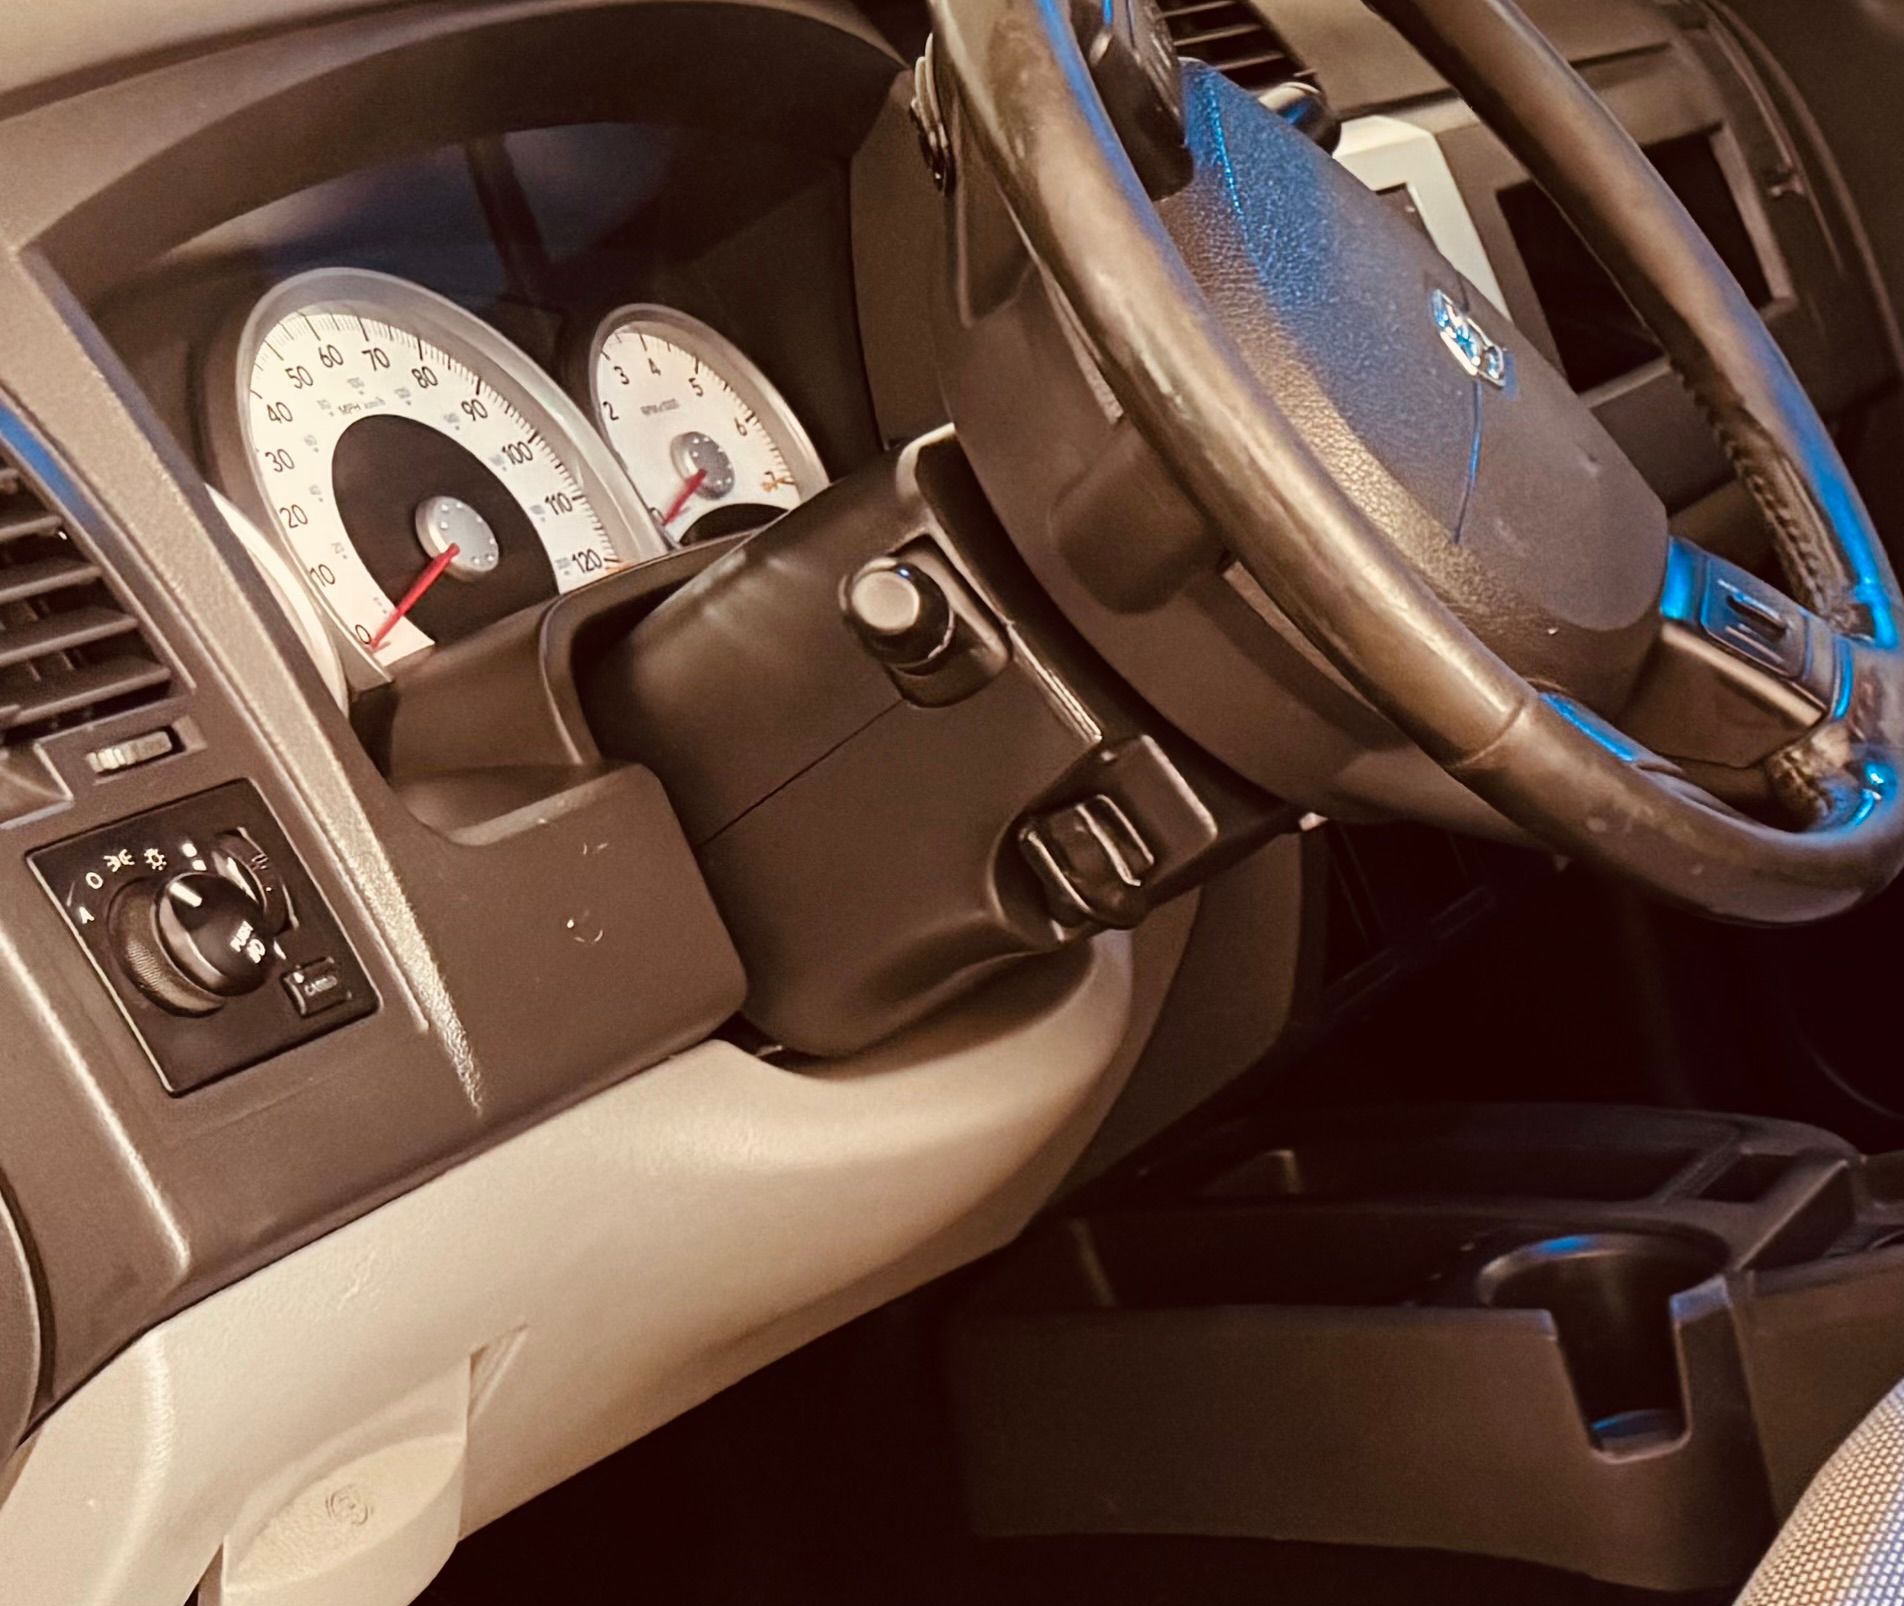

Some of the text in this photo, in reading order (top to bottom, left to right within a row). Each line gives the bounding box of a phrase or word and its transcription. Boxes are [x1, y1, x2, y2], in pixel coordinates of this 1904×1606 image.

[319, 345, 343, 368] 60
[362, 348, 390, 371] 70
[648, 358, 661, 376] 4
[285, 366, 313, 389] 50
[411, 366, 438, 388] 80
[613, 366, 630, 385] 3
[688, 377, 704, 397] 5
[266, 402, 293, 424] 40
[461, 399, 488, 421] 90
[602, 401, 619, 421] 2
[734, 417, 748, 437] 6
[265, 449, 295, 472] 30
[502, 441, 534, 465] 100
[545, 492, 573, 515] 110
[280, 504, 308, 528] 20
[572, 549, 602, 574] 120
[309, 564, 336, 588] 10
[355, 624, 372, 645] 0
